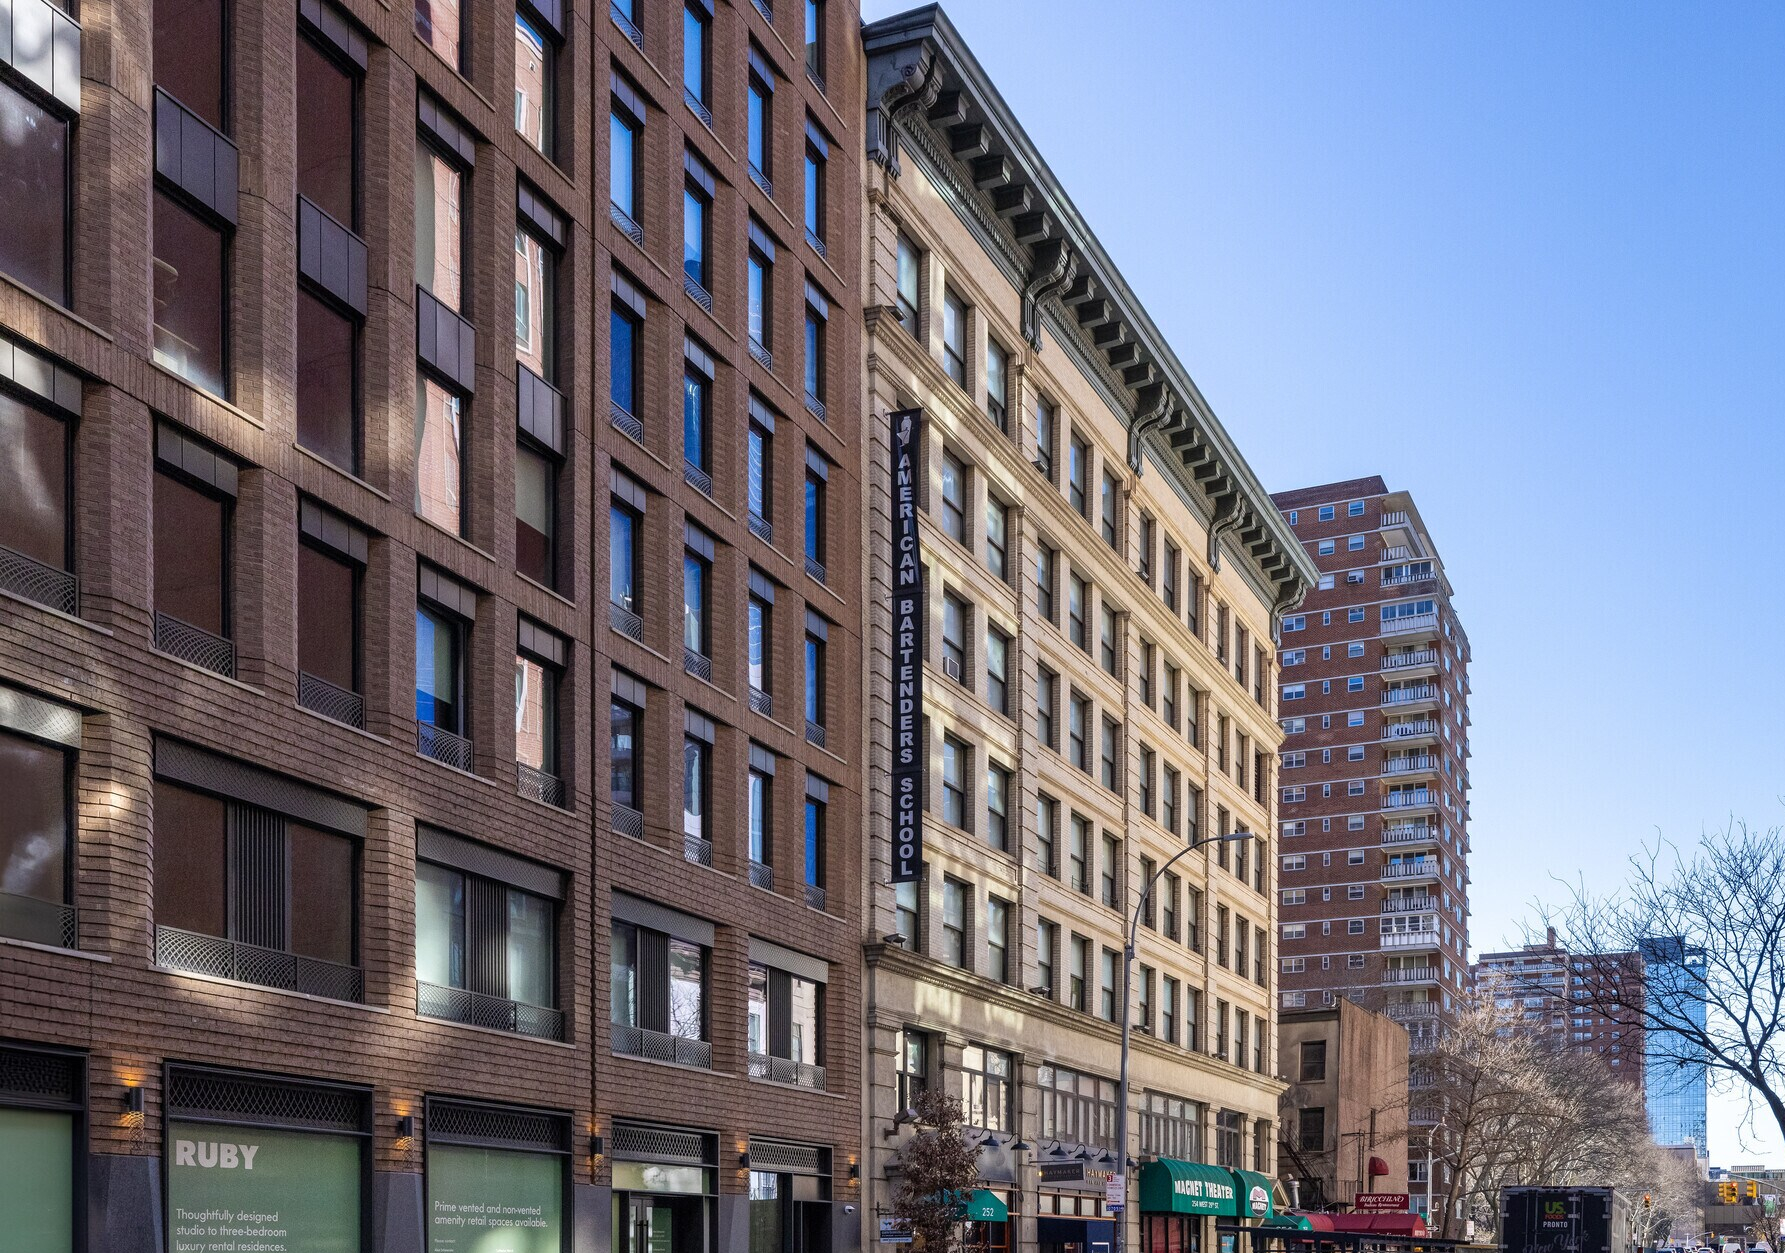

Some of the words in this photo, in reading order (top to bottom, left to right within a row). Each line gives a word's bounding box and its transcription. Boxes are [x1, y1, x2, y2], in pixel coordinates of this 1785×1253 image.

[898, 453, 914, 586] AMERICAN
[899, 599, 914, 764] BARTENDERS
[899, 777, 914, 876] SCHOOL
[175, 1140, 260, 1170] RUBY
[1174, 1180, 1202, 1196] MAGNET
[1205, 1182, 1233, 1199] THEATER
[434, 1200, 457, 1213] Prime
[458, 1203, 485, 1214] vented
[486, 1203, 501, 1214] and
[502, 1205, 541, 1216] non-vented
[982, 1207, 994, 1217] 252
[1252, 1201, 1267, 1211] MAGNET
[176, 1208, 235, 1224] Thoughtfully
[236, 1211, 279, 1224] designed
[434, 1215, 466, 1228] amenity
[467, 1216, 487, 1226] retail
[488, 1218, 514, 1229] spaces
[514, 1218, 549, 1229] available.
[176, 1224, 206, 1236] studio
[207, 1227, 218, 1237] to
[219, 1225, 287, 1237] three-bedroom
[176, 1240, 206, 1253] luxury
[208, 1240, 236, 1252] rental
[237, 1240, 288, 1252] residences.
